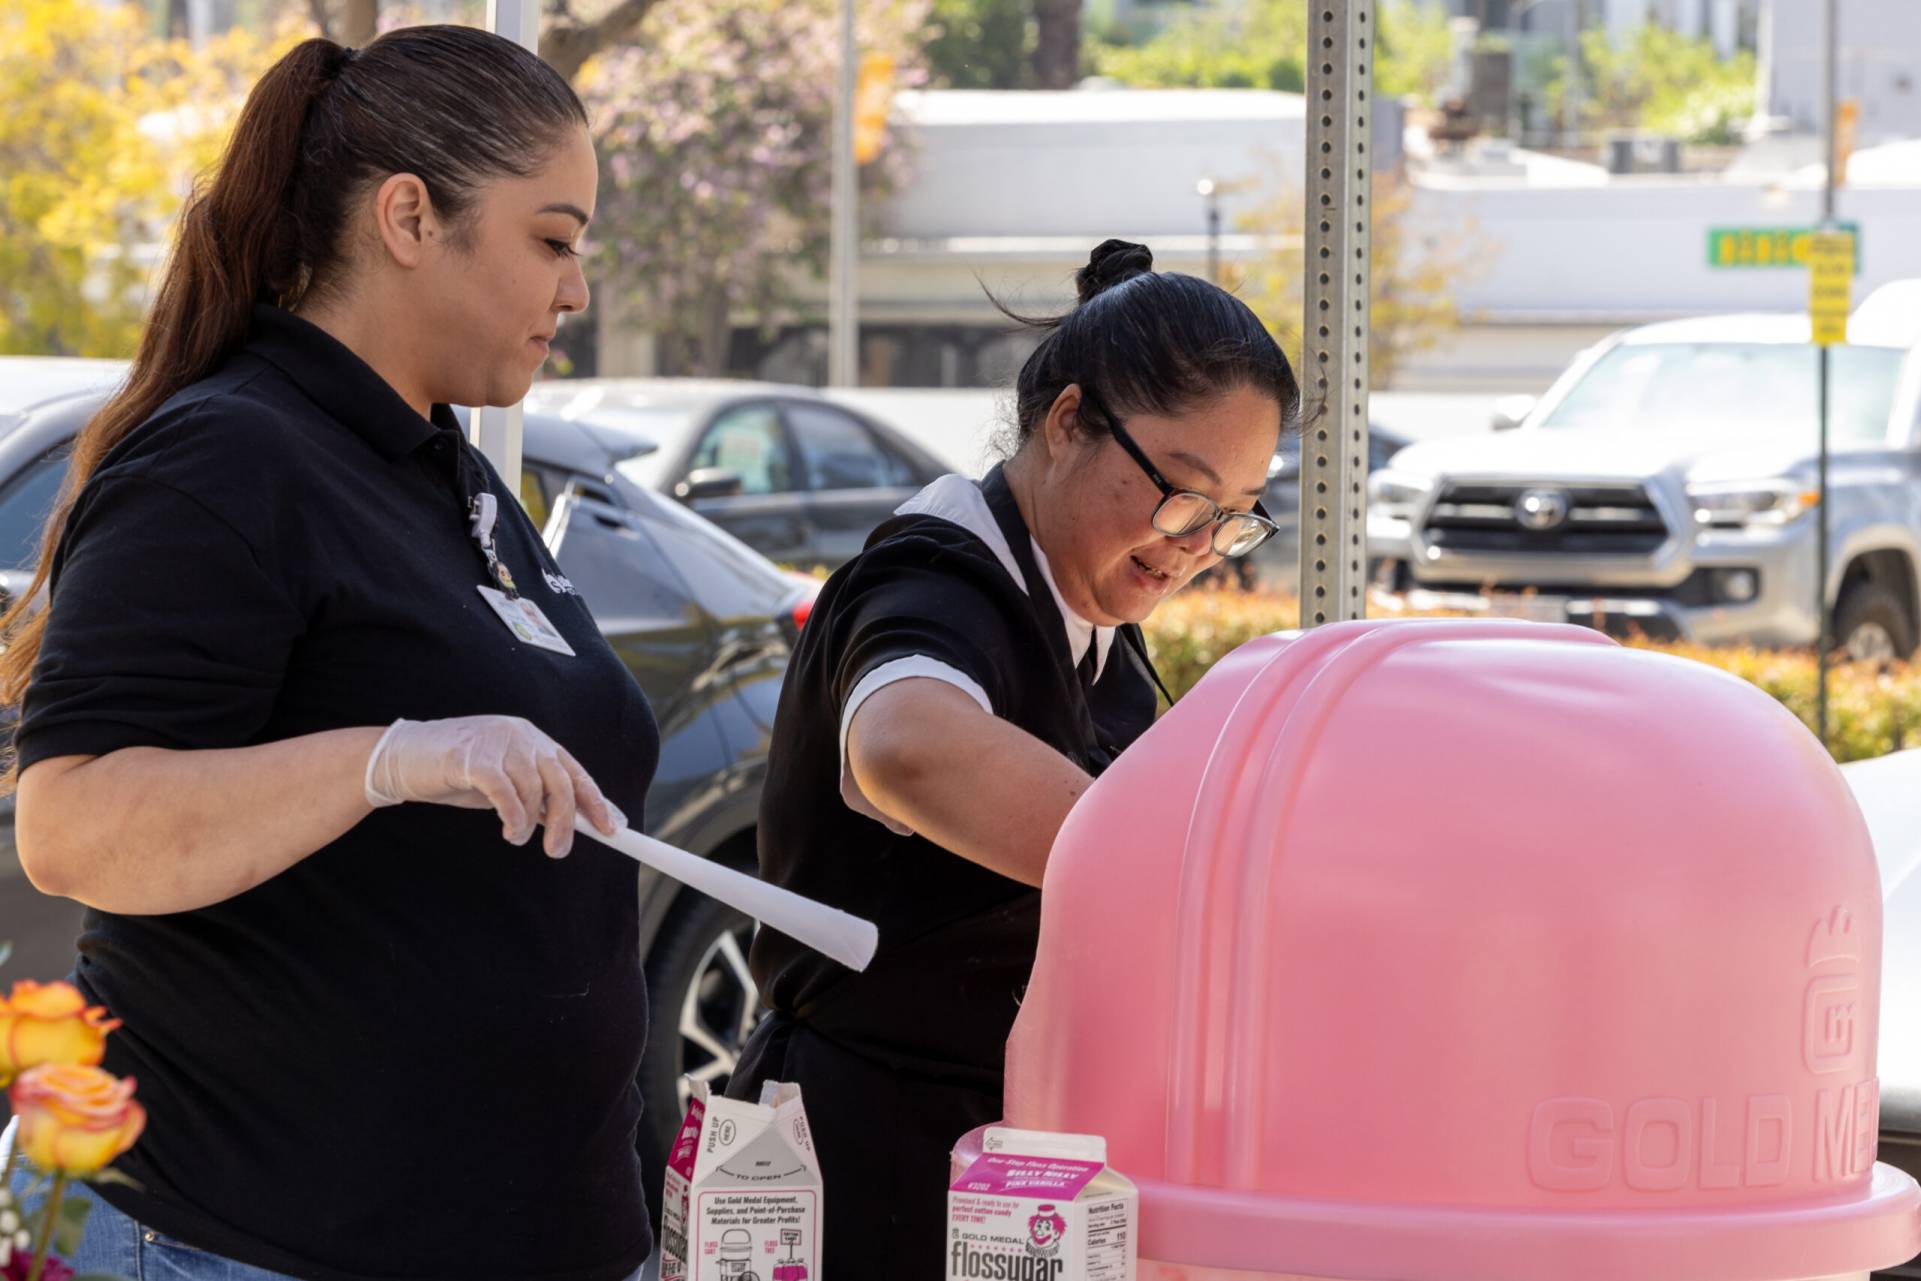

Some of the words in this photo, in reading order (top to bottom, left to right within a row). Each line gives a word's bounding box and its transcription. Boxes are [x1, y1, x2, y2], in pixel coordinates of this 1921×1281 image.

[712, 1116, 720, 1128] UP
[707, 1130, 718, 1153] PUSH
[1527, 1093, 1791, 1193] GOLD
[714, 1196, 726, 1204] Use
[727, 1196, 742, 1204] Gold
[743, 1196, 762, 1204] Medal
[763, 1195, 798, 1205] Equipment,
[981, 1199, 995, 1207] ready
[706, 1207, 734, 1215] Supplies,
[736, 1206, 749, 1214] and
[952, 1205, 974, 1213] perfect
[974, 1207, 993, 1215] cotton
[994, 1209, 1012, 1217] candy
[1088, 1205, 1110, 1214] Nutrition
[1111, 1203, 1124, 1211] Facts
[741, 1216, 752, 1224] for
[752, 1216, 776, 1224] Greater
[777, 1215, 800, 1223] Profits!
[952, 1214, 970, 1223] EVERY
[962, 1233, 987, 1242] GOLD
[990, 1235, 1025, 1245] MEDAL
[1088, 1238, 1106, 1246] Calories
[951, 1241, 1063, 1281] flossugar
